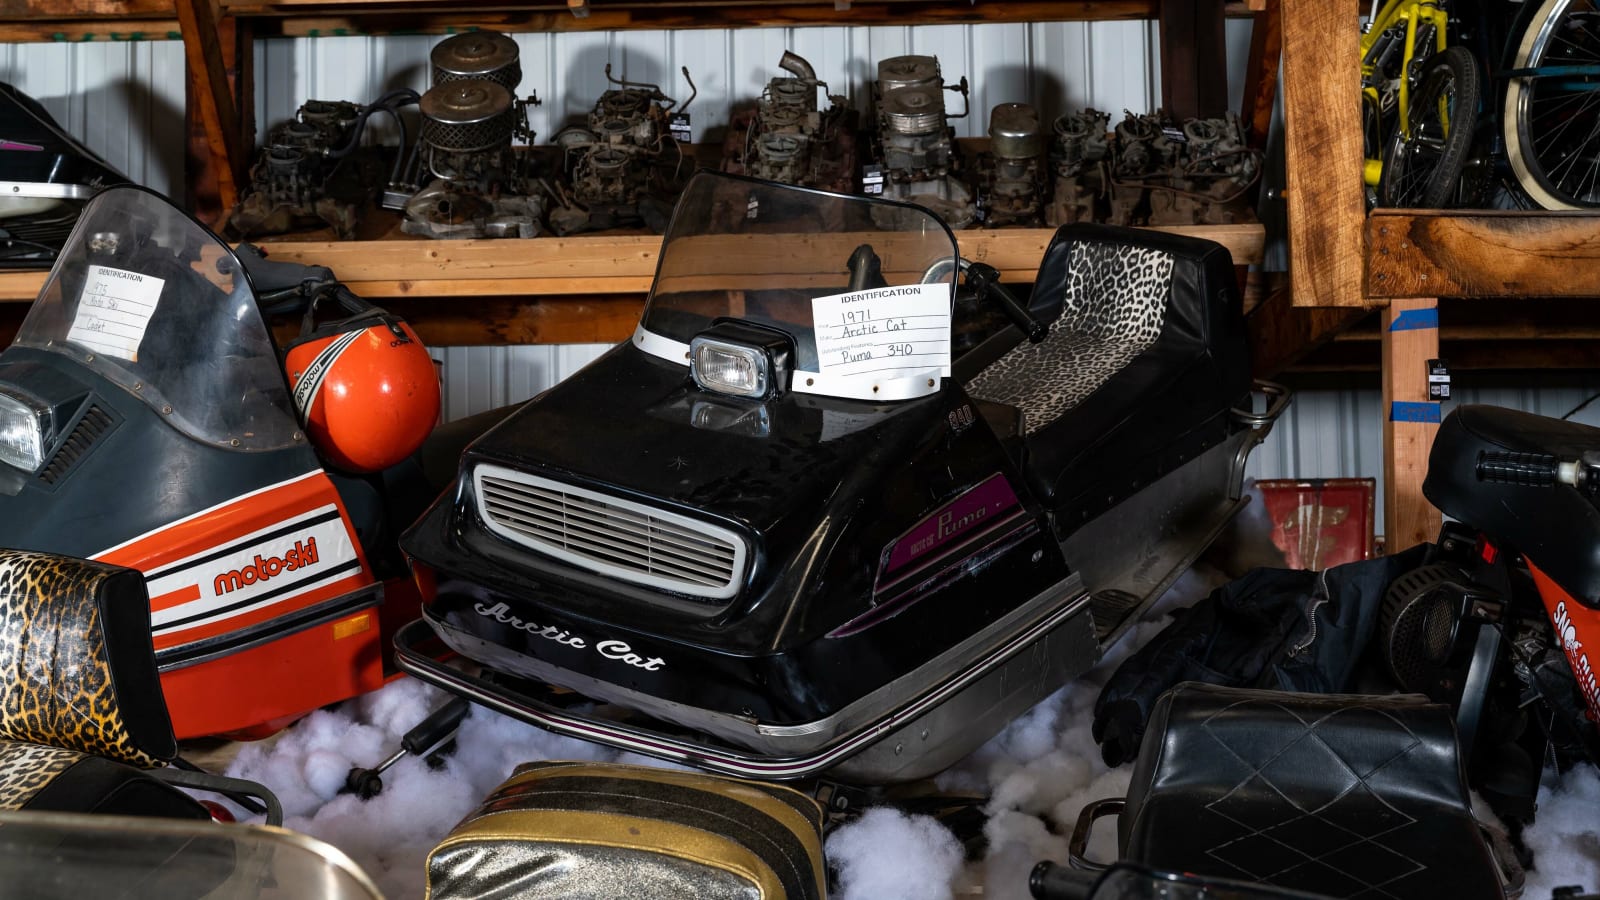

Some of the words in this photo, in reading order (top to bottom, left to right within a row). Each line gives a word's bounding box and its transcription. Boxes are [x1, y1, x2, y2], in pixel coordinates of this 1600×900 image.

[98, 268, 143, 282] IDENTIFICATION
[841, 287, 921, 304] IDENTIFICATION
[841, 308, 871, 324] 1971
[842, 325, 879, 339] Arctic
[886, 319, 908, 332] Cat
[842, 350, 873, 364] Puma
[887, 343, 913, 358] 340
[938, 507, 986, 540] Puma
[474, 602, 587, 648] Arctic
[595, 639, 666, 671] Cat
